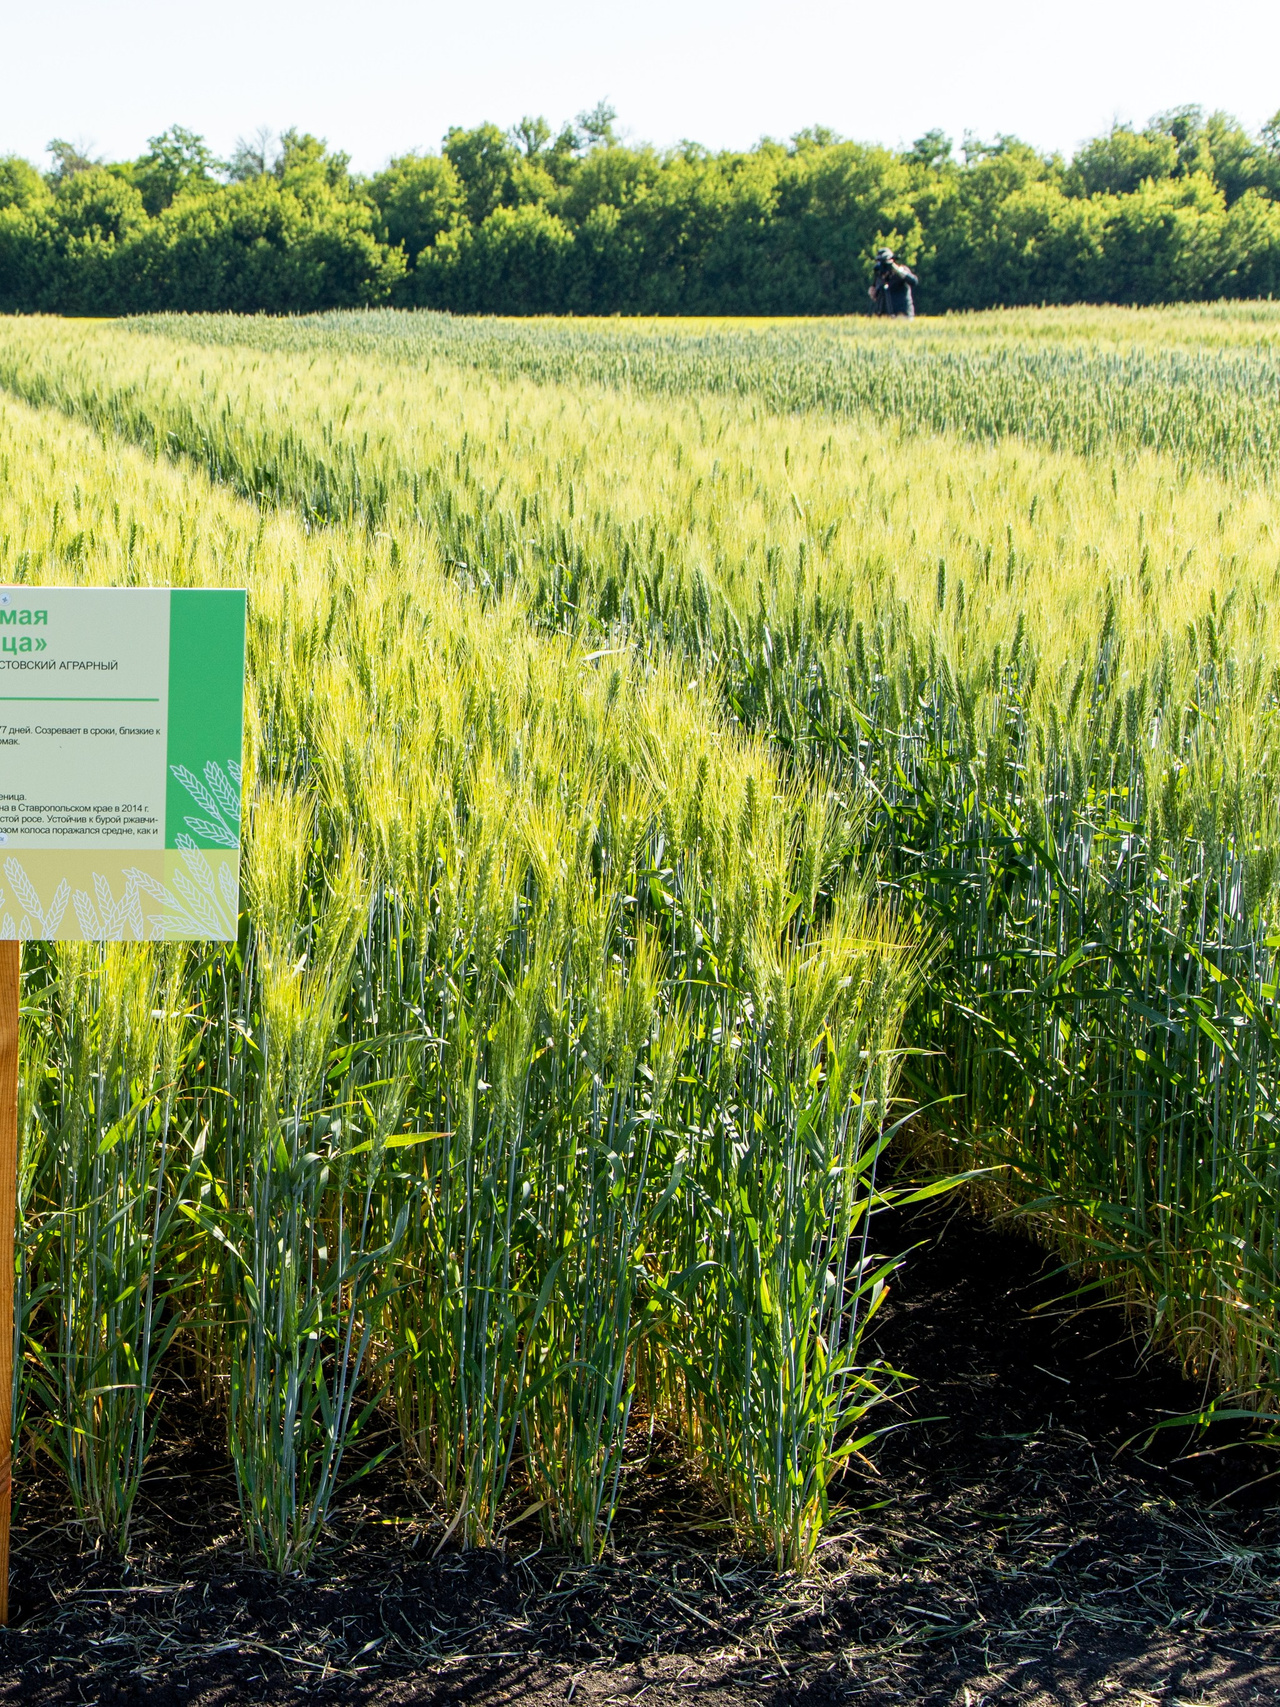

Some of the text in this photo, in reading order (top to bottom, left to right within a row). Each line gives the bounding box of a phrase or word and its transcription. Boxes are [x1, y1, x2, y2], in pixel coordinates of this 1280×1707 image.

[58, 660, 117, 670] АГРАРНЫЙ
[8, 726, 32, 734] дней.
[34, 726, 81, 735] Созревает
[119, 726, 154, 735] близкие
[18, 803, 90, 813] Ставропольском
[46, 814, 86, 823] Устойчив
[95, 815, 120, 825] бурой
[123, 816, 158, 824] ржавчи-
[52, 827, 99, 835] поражался
[101, 828, 135, 836] средне,
